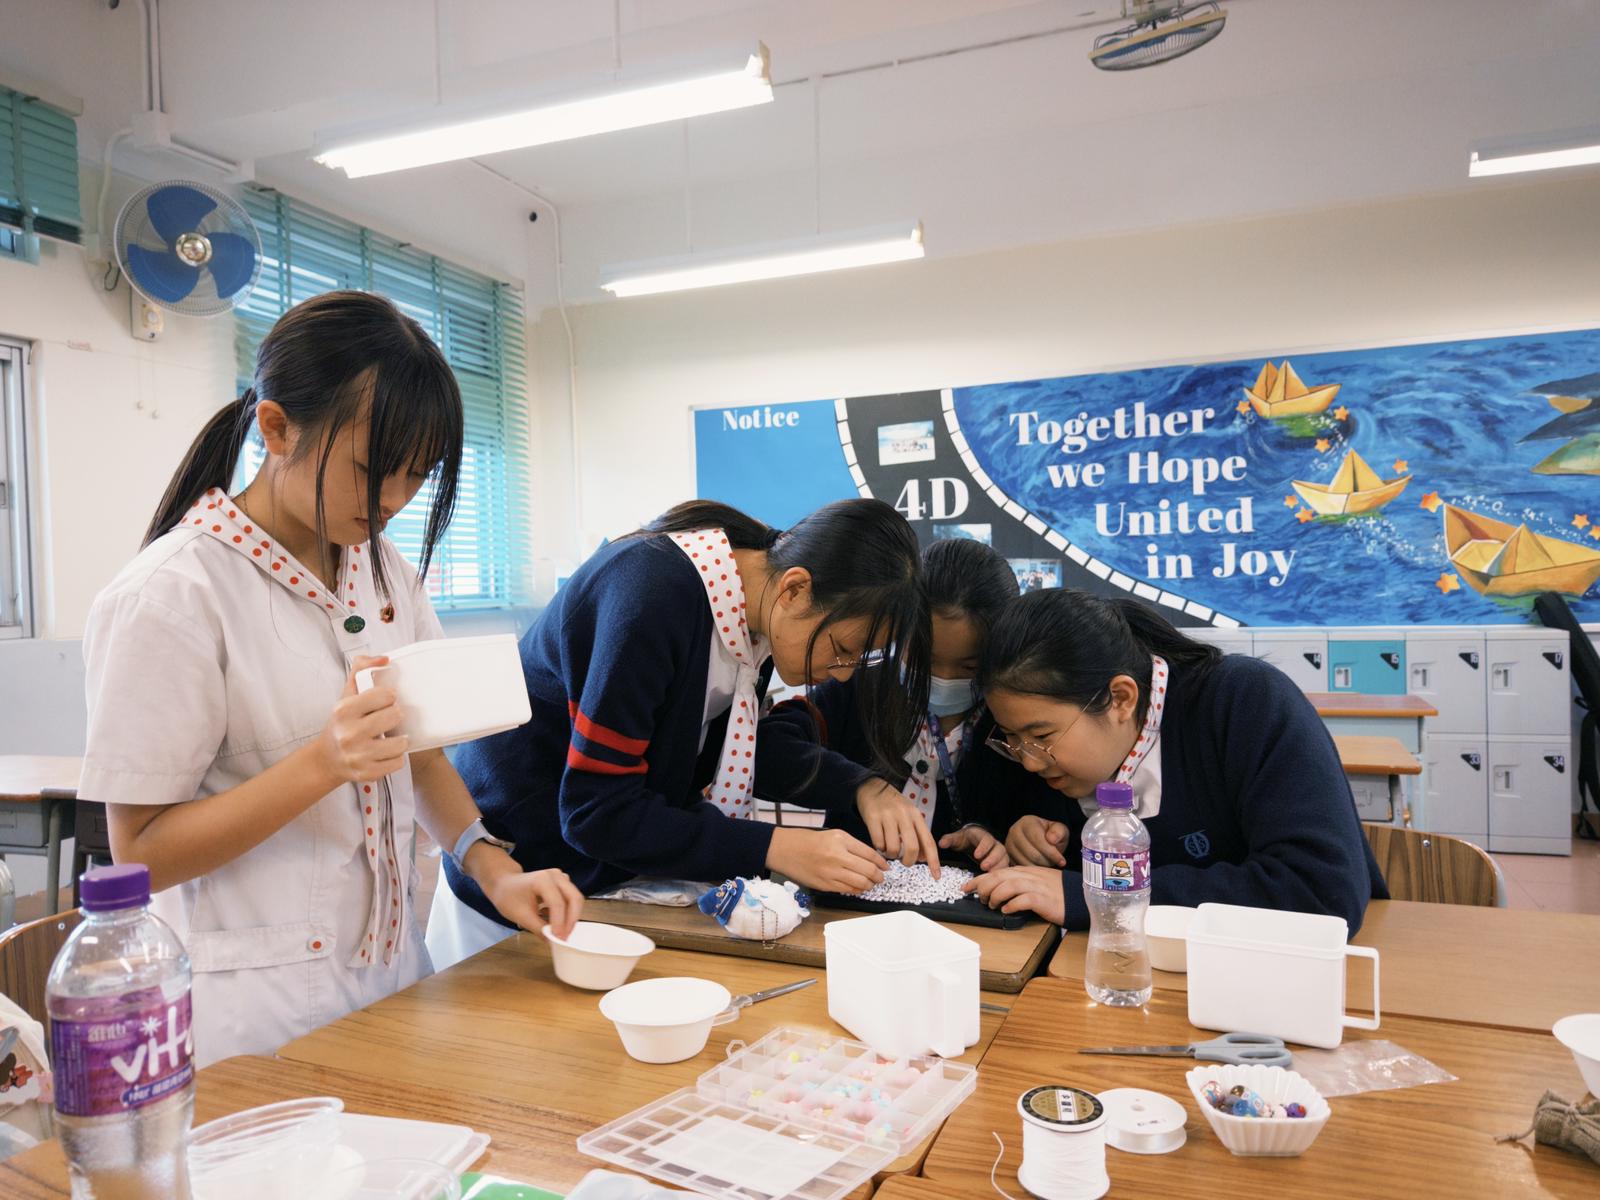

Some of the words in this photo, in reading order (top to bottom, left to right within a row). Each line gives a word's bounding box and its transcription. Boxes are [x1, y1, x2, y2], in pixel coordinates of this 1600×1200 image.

[722, 406, 801, 431] Notice
[1008, 401, 1216, 455] Together
[1047, 462, 1106, 489] we
[1127, 451, 1248, 496] Hope
[893, 477, 970, 521] 4D
[1095, 496, 1256, 537] United
[1145, 543, 1195, 580] in
[1211, 543, 1298, 588] Joy
